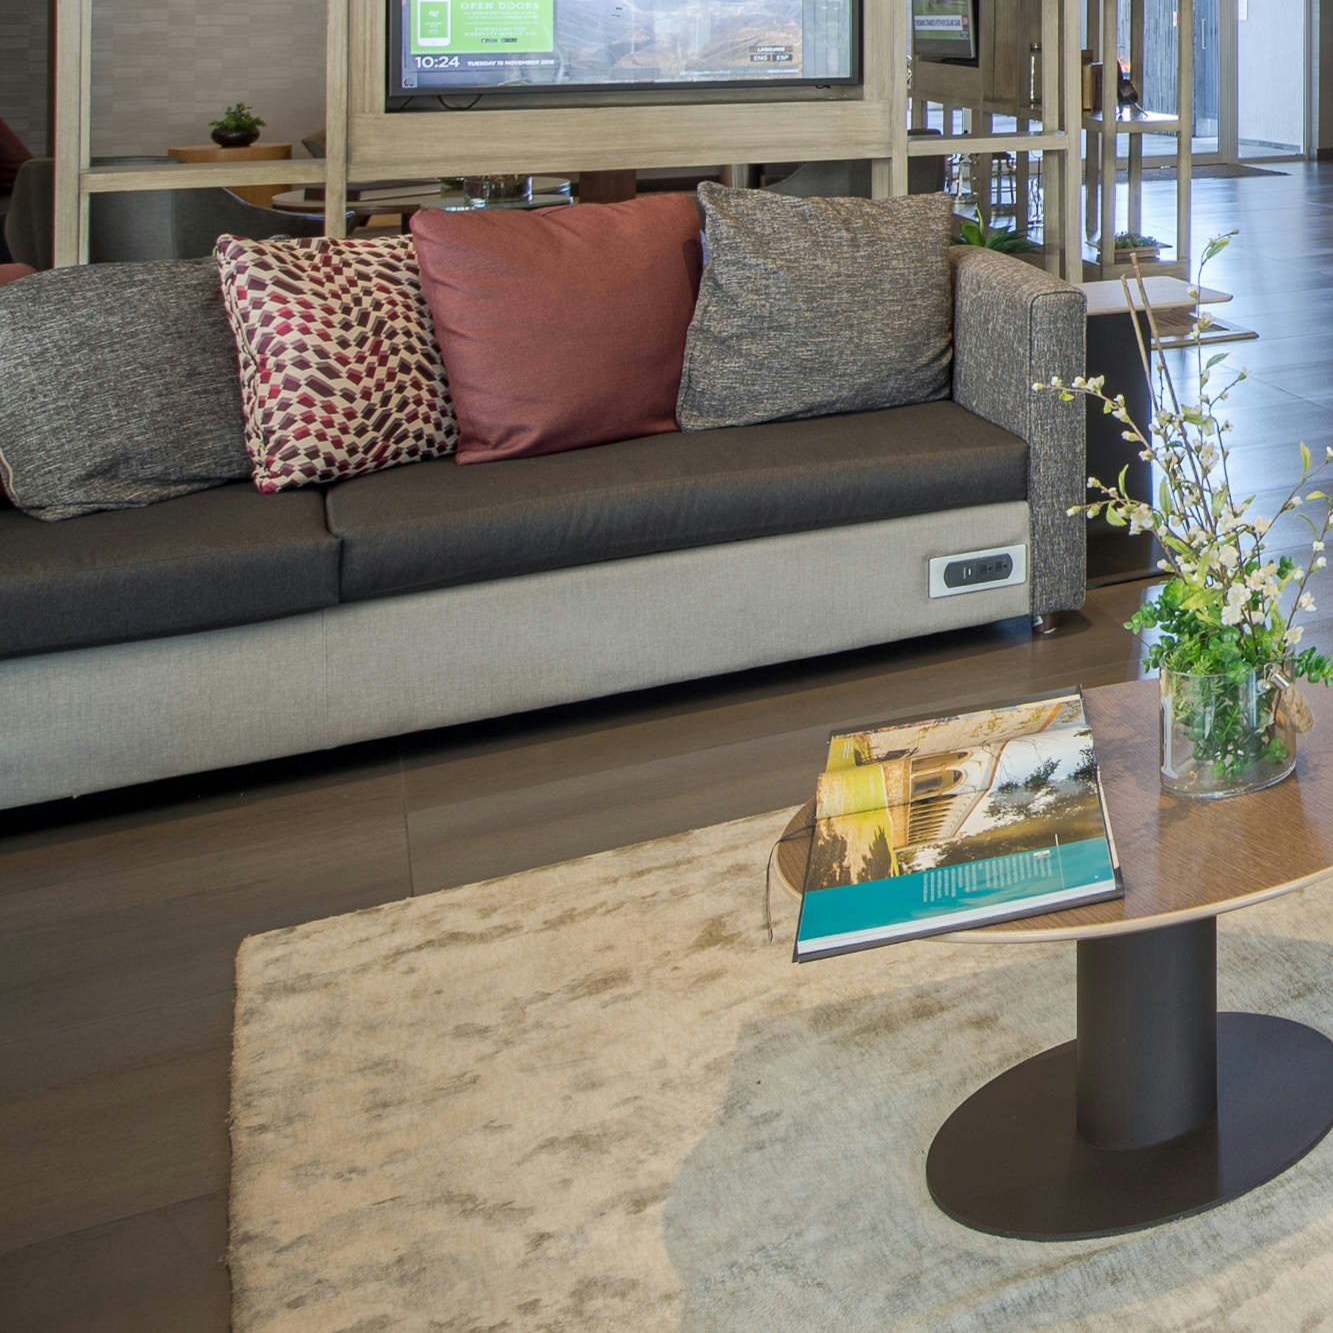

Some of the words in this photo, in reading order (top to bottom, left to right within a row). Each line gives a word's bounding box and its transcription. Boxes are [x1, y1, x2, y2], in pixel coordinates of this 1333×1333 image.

[460, 1, 494, 11] OPEN
[498, 1, 540, 11] DOORS
[415, 56, 460, 68] 10:24
